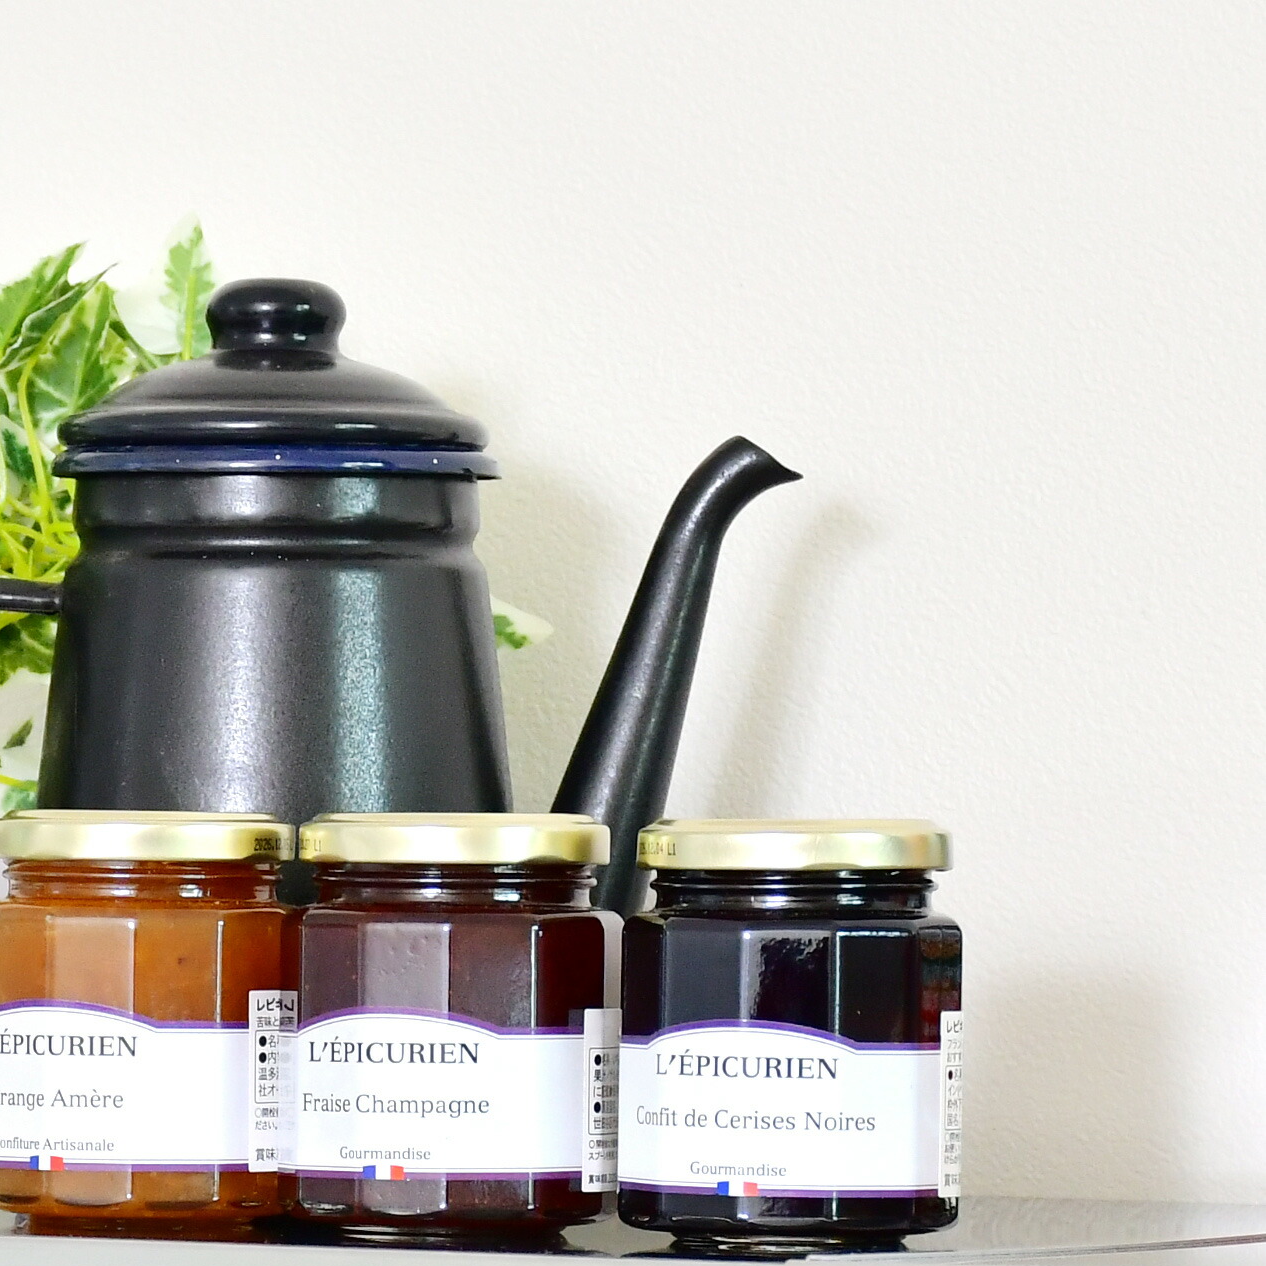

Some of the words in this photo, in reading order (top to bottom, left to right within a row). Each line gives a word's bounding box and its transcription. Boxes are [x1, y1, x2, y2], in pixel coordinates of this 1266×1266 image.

[308, 1036, 480, 1064] L'ÉPICURIEN
[655, 1049, 839, 1080] L'ÉPICURIEN
[50, 1088, 124, 1109] Amère
[302, 1092, 351, 1113] Fraise
[355, 1093, 490, 1119] Champagne
[636, 1104, 678, 1127] Confit
[684, 1108, 708, 1128] de
[714, 1108, 796, 1131] Cerises
[804, 1111, 876, 1132] Noires
[42, 1137, 115, 1152] Artisanale
[339, 1145, 431, 1161] Gourmandise
[689, 1160, 787, 1177] Gourmandise
